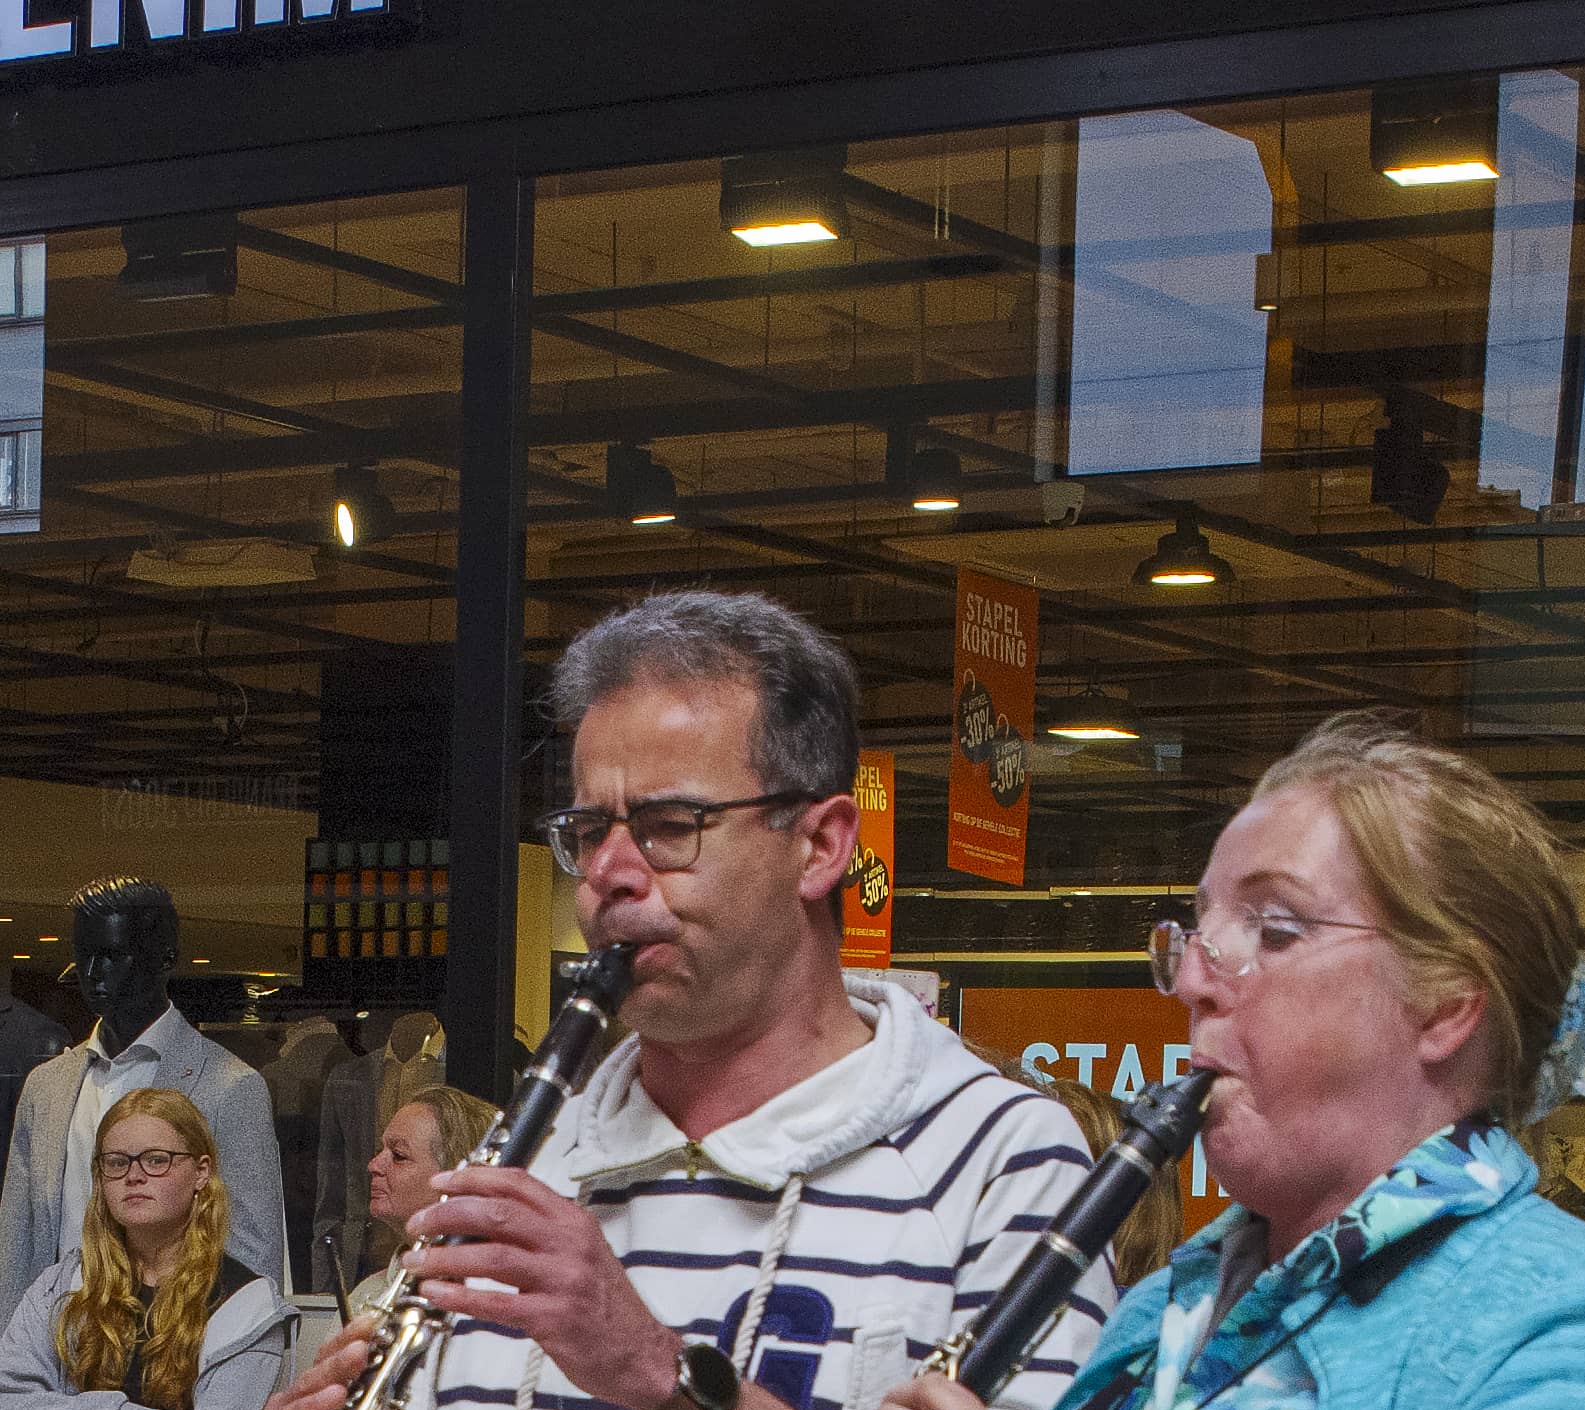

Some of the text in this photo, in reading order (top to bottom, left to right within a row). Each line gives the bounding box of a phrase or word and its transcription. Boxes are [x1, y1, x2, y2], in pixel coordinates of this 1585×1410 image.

[965, 591, 1024, 638] STAPEL
[961, 620, 1027, 668] KORTING
[861, 872, 889, 907] -50%
